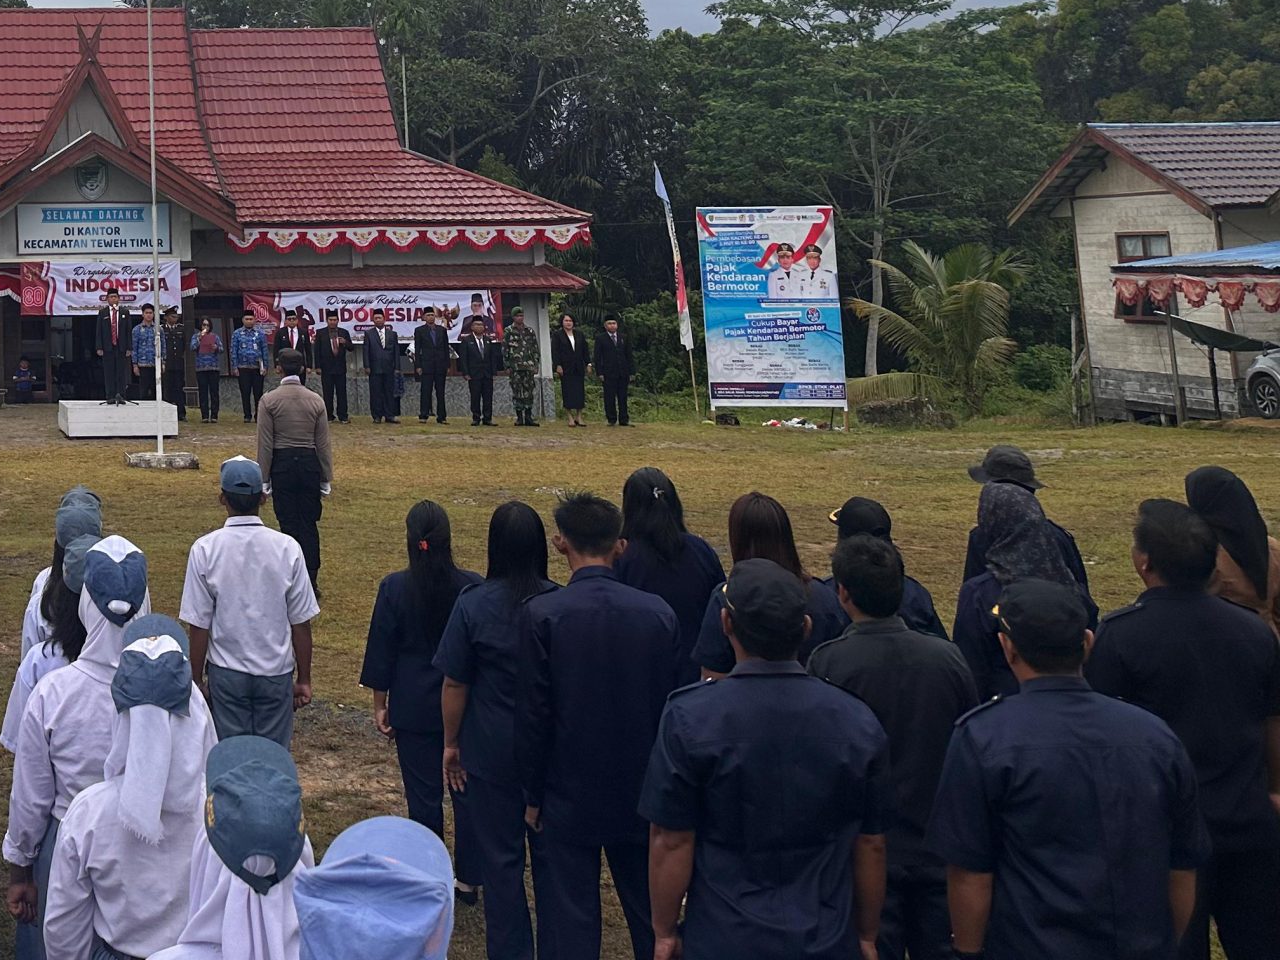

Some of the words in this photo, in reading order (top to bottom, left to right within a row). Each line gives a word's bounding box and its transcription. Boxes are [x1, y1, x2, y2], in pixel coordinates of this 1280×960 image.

[46, 210, 93, 220] SELAMAT
[99, 209, 138, 219] DATANG
[64, 227, 74, 236] DI
[77, 226, 121, 236] KANTOR
[24, 239, 88, 249] KECAMATAN
[92, 239, 127, 248] TEWEH
[73, 266, 120, 280] Dirgahayu
[706, 263, 736, 274] Pajak
[707, 273, 766, 281] Kendaraan
[66, 277, 169, 293] INDONESIA
[708, 282, 759, 291] Bermotor
[22, 286, 46, 307] 80
[326, 295, 374, 309] Dirgahayu
[376, 294, 419, 307] Republik
[725, 329, 746, 337] Pajak
[747, 327, 788, 335] Kendaraan
[789, 325, 825, 333] Bermotor
[774, 333, 804, 342] Berjalan
